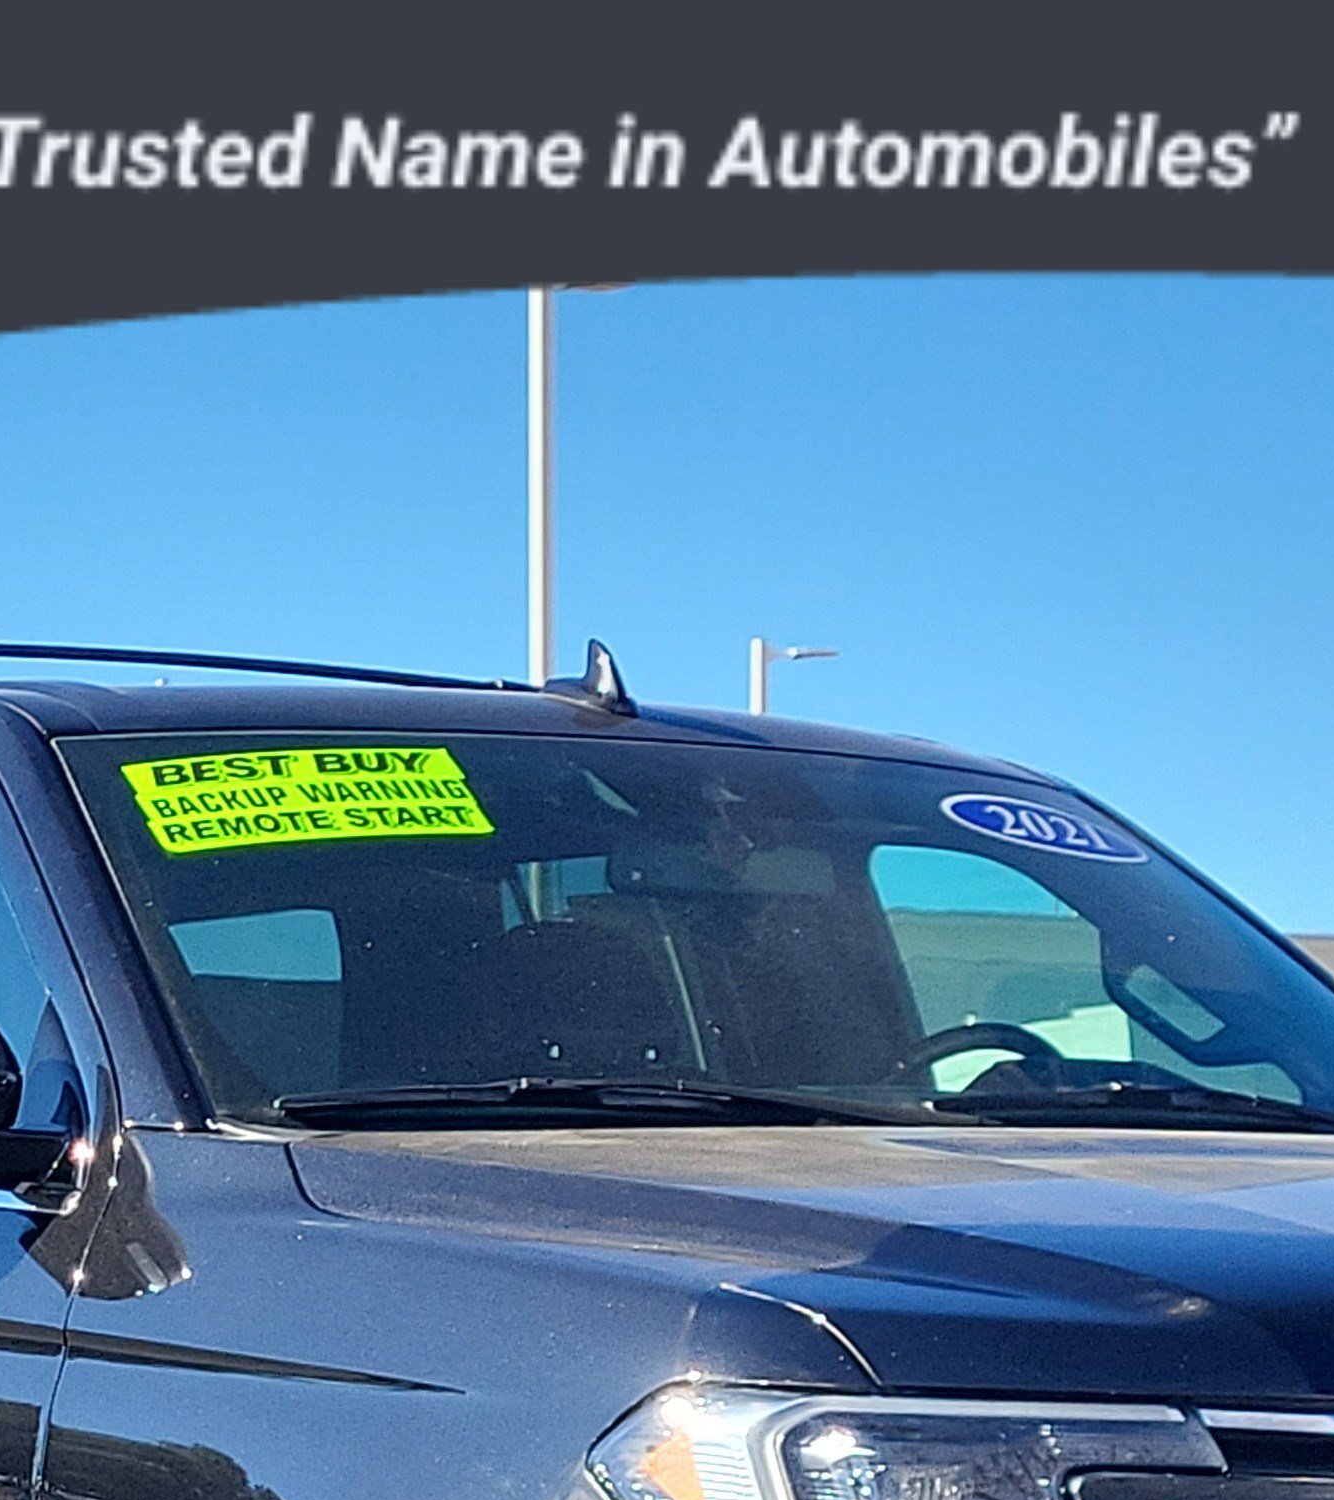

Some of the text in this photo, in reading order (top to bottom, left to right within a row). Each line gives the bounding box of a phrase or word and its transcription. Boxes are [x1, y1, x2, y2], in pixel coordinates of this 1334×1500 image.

[151, 751, 427, 788] BEST BUY
[151, 779, 468, 819] BACKUP WARNING
[162, 805, 469, 844] REMOTE START
[983, 804, 1115, 851] 2021
